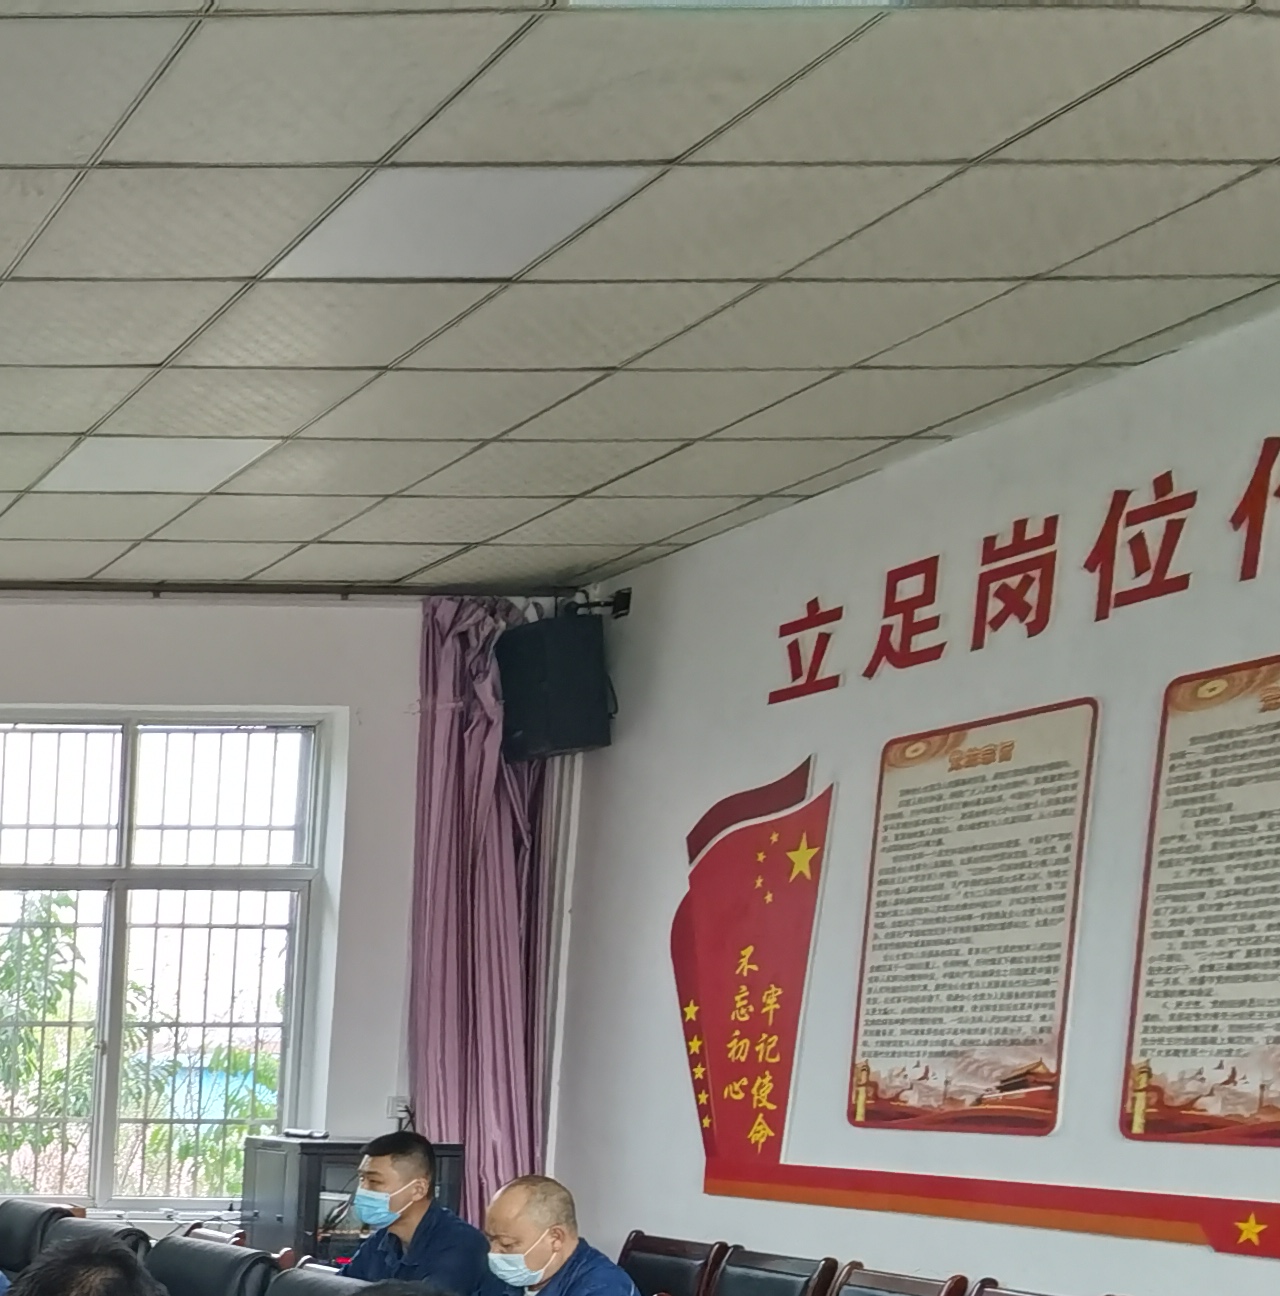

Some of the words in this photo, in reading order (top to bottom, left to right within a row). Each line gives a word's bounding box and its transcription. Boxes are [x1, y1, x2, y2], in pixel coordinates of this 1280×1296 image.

[723, 944, 760, 1101] 不忘初心
[747, 983, 784, 1155] 牢记使命
